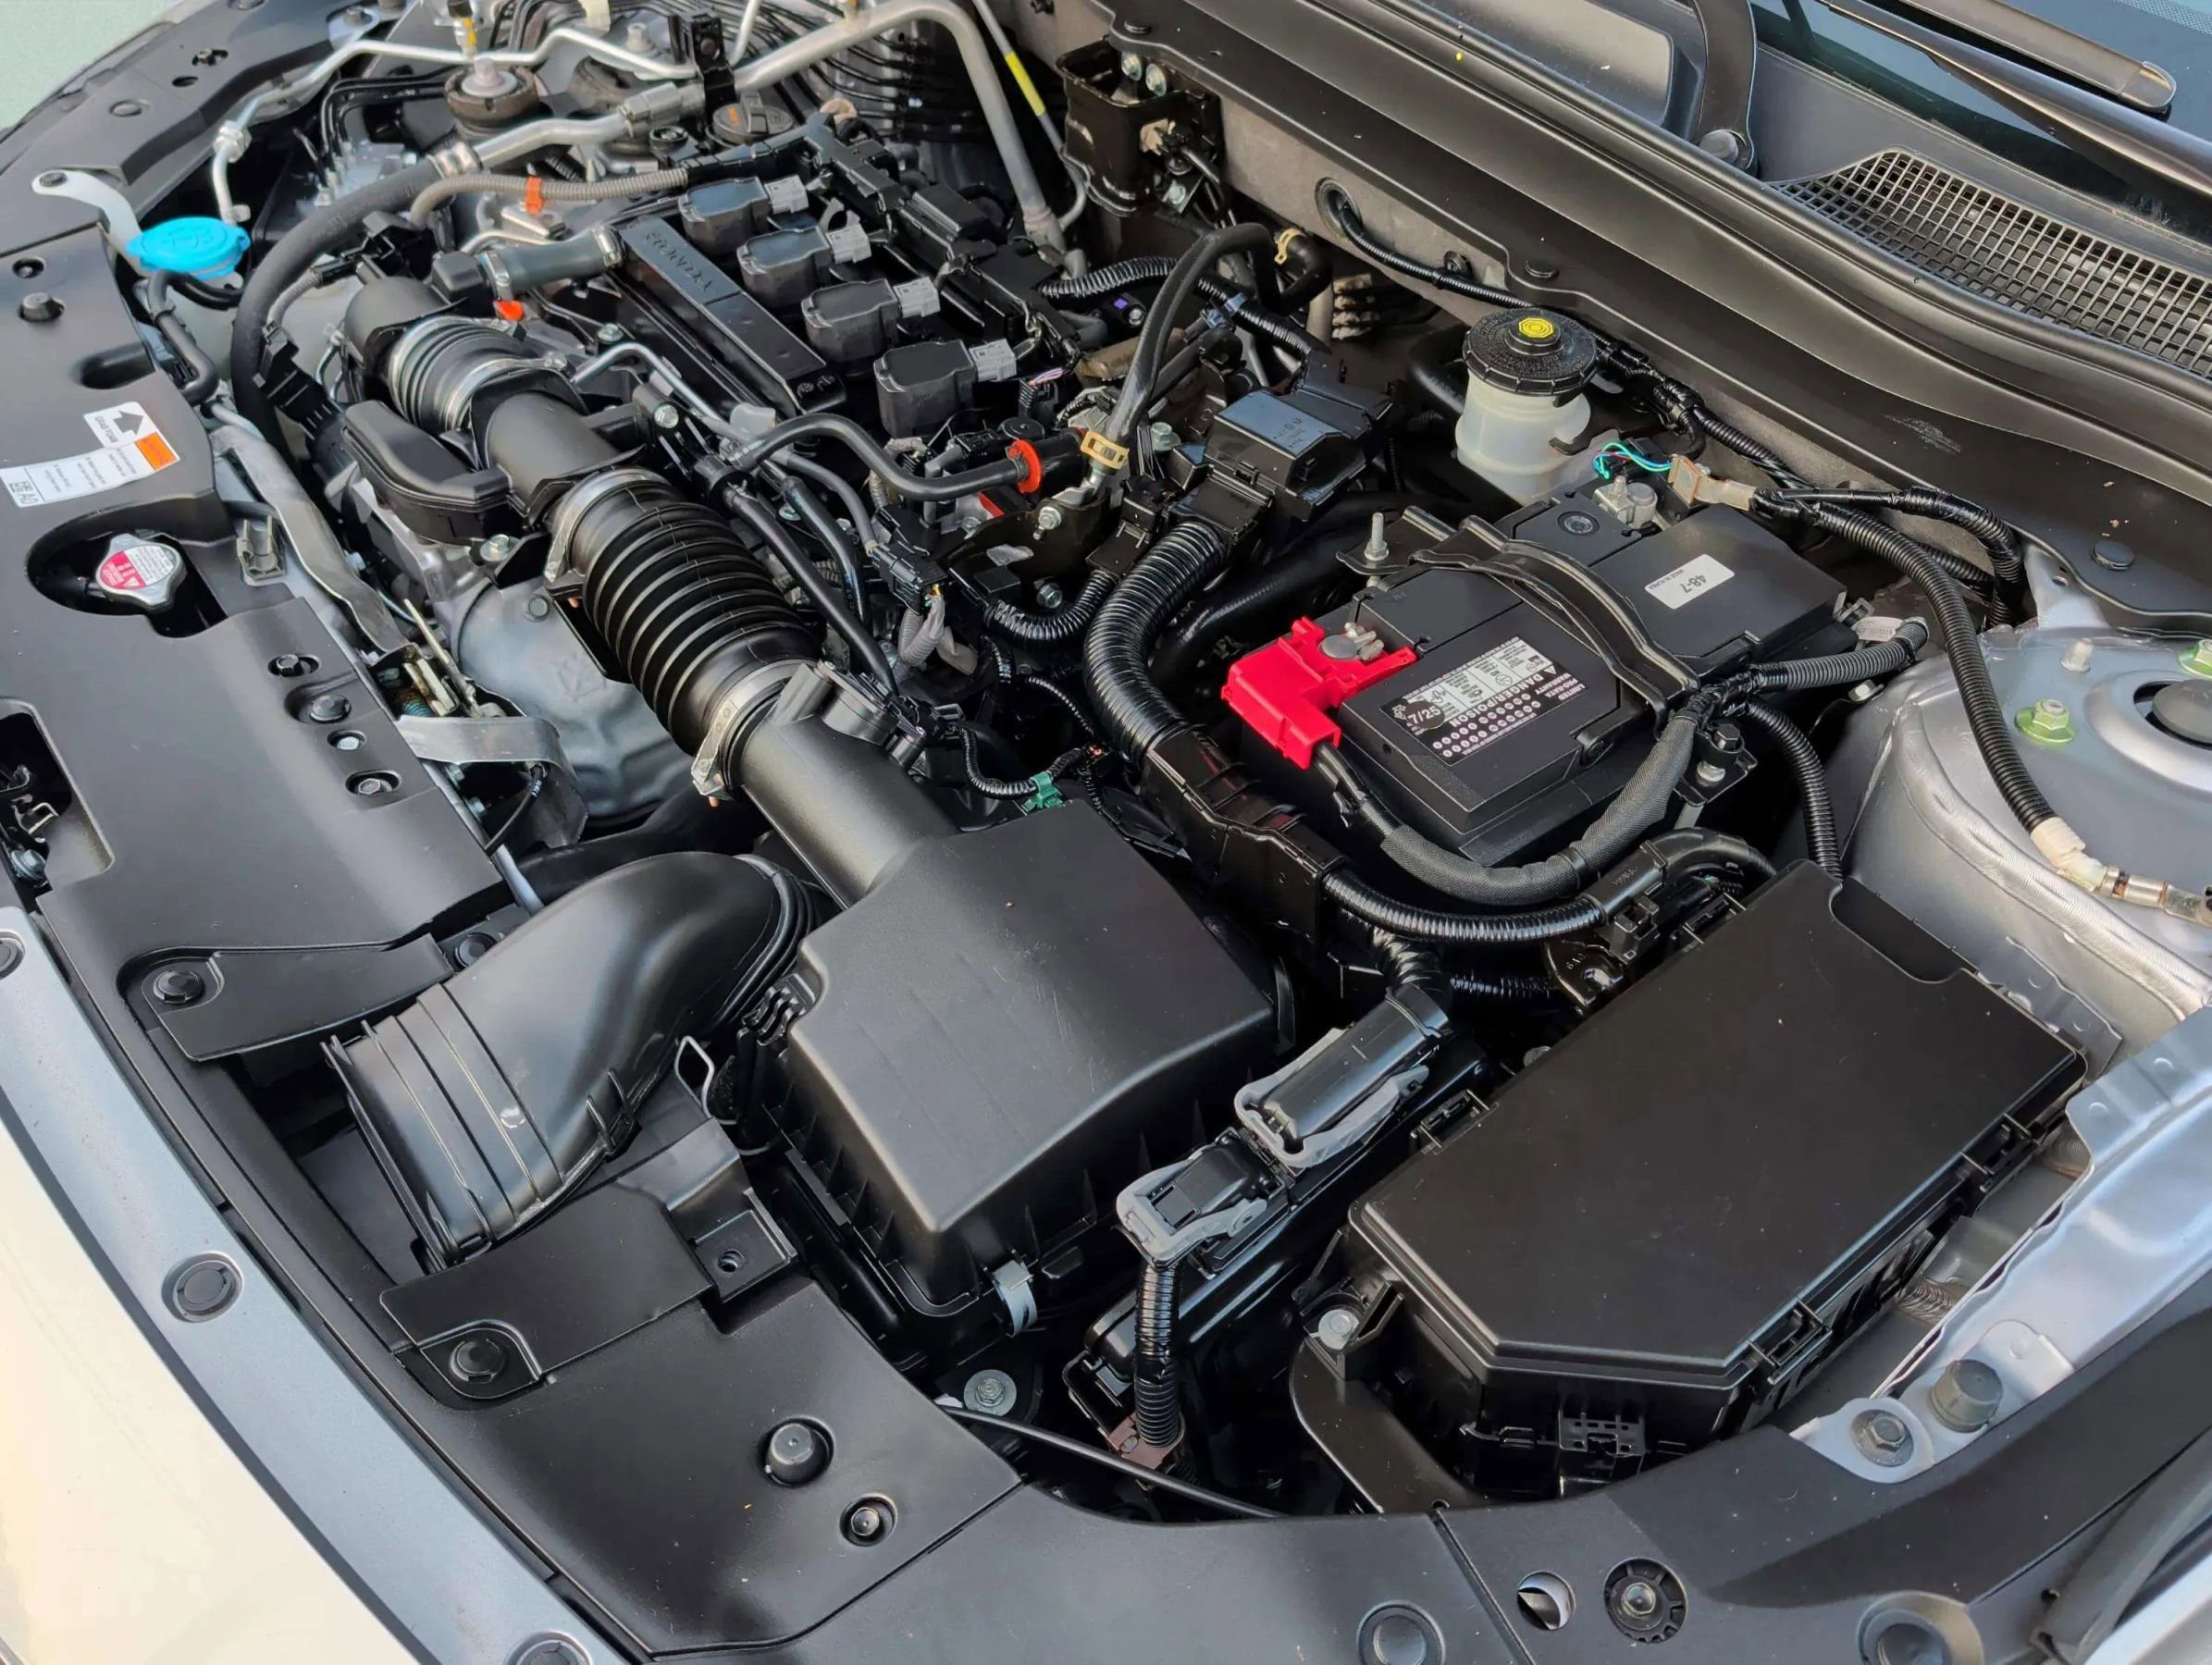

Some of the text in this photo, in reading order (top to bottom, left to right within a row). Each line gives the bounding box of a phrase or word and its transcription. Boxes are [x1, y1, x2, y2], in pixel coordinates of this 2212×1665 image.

[1680, 574, 1707, 593] 48-7
[1535, 672, 1571, 695] WARRANTY
[1544, 677, 1578, 698] PRO-RATA
[1557, 684, 1586, 700] LIMITED
[1448, 673, 1543, 728] DANGER/POISON
[1407, 706, 1441, 725] 7/25
